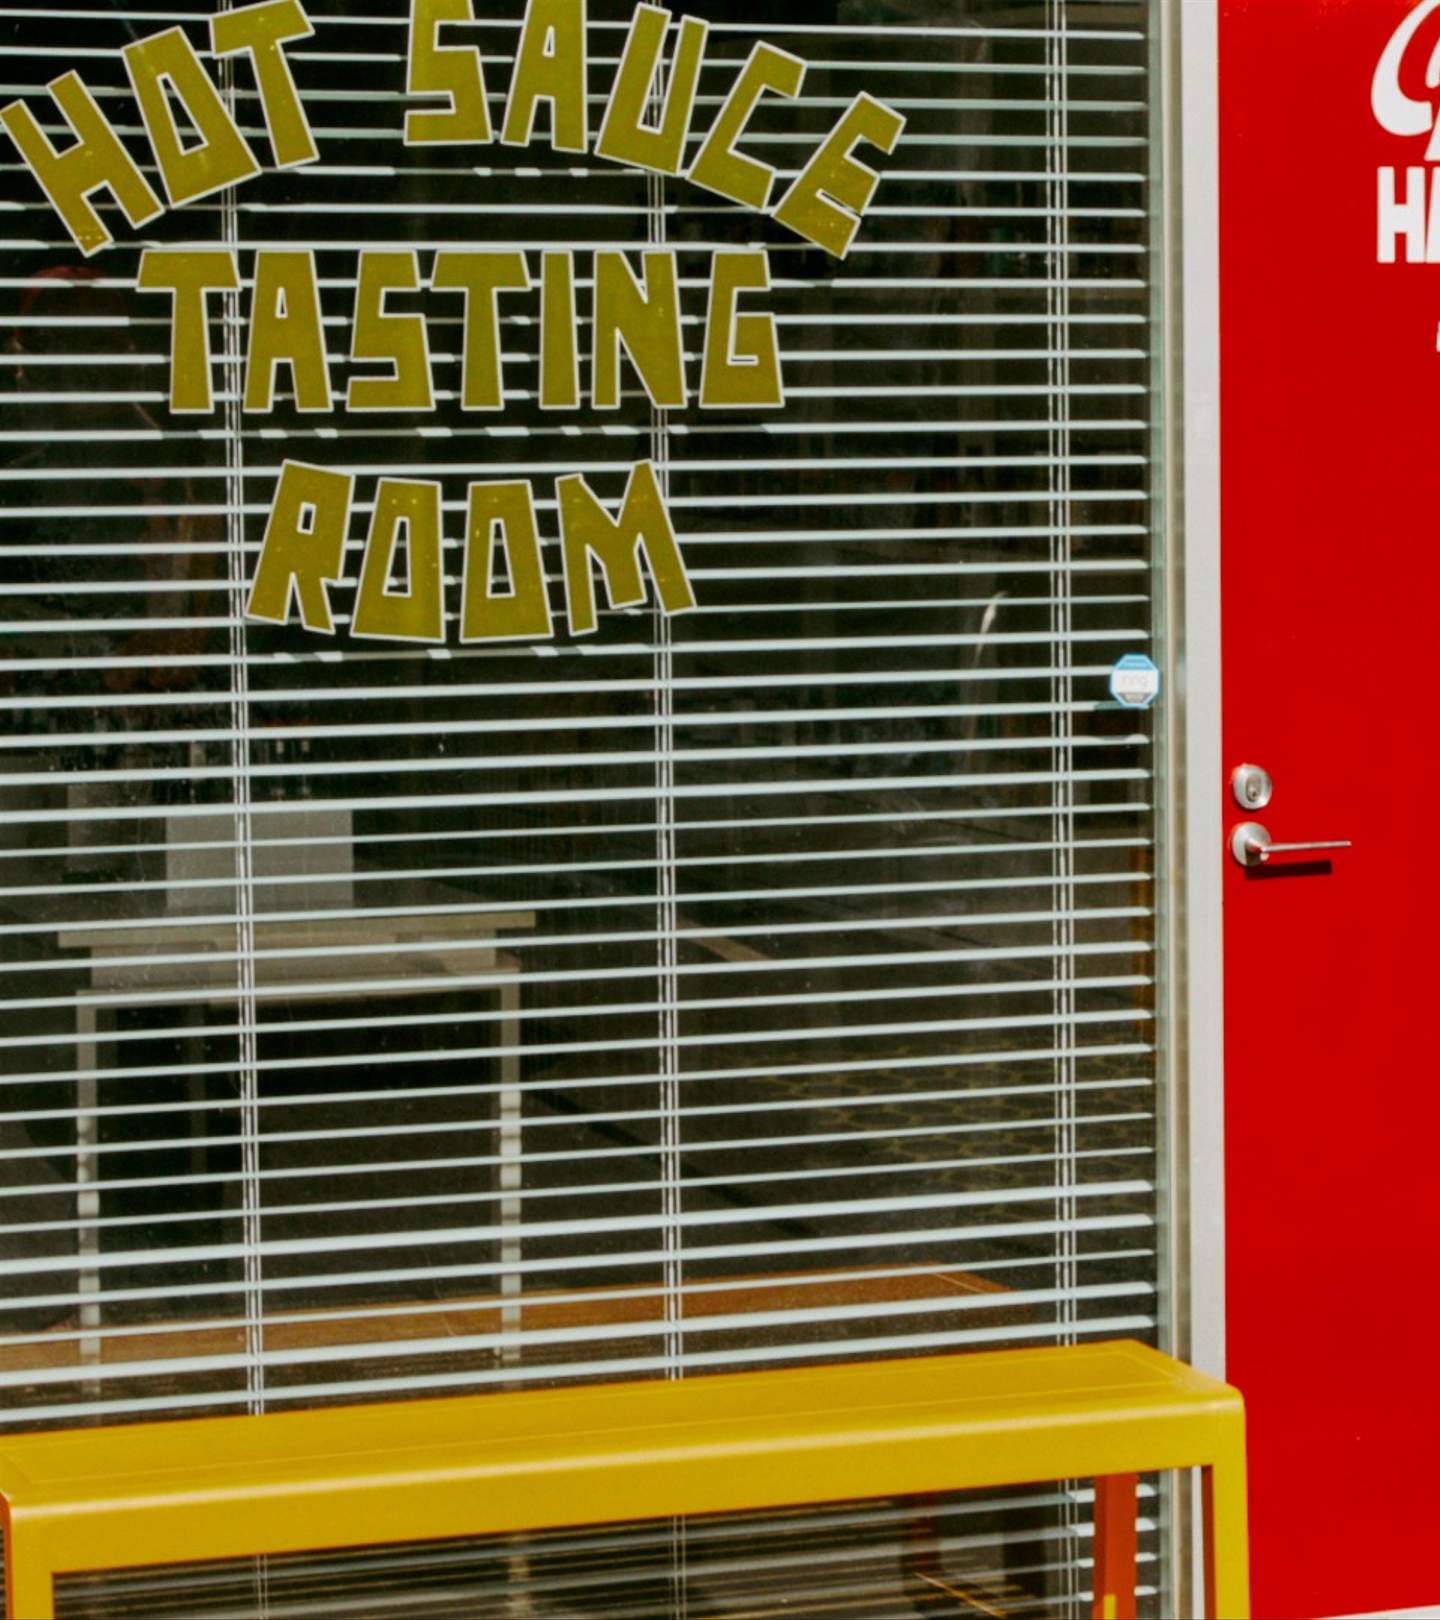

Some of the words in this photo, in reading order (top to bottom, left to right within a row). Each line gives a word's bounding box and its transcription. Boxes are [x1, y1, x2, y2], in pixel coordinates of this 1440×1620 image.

[0, 0, 320, 258] HOT
[403, 0, 907, 261] SAUCE
[136, 249, 785, 413] TASTING
[245, 459, 698, 643] ROOM
